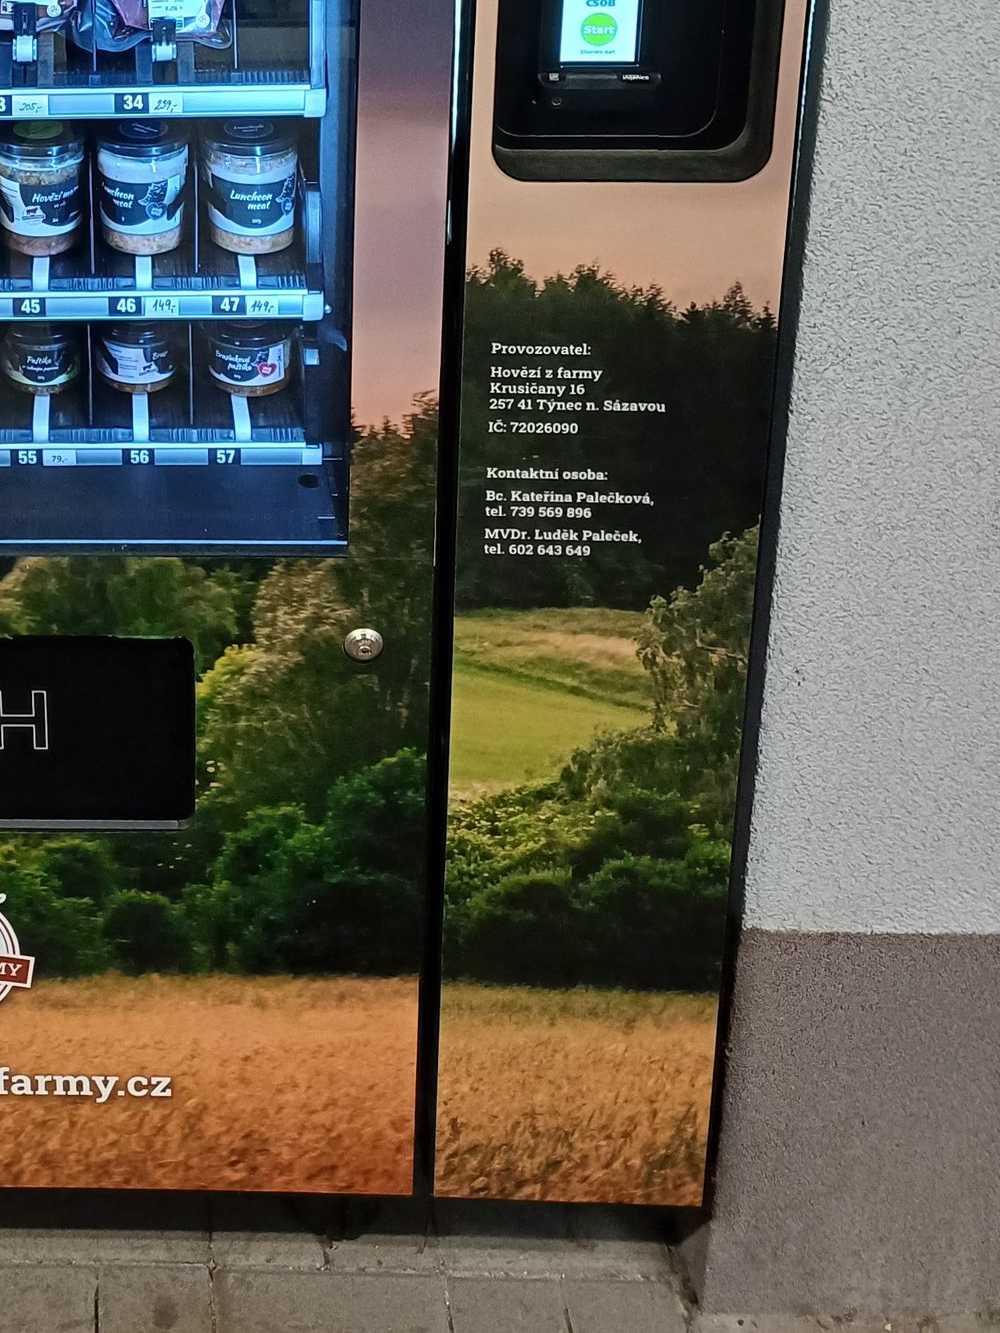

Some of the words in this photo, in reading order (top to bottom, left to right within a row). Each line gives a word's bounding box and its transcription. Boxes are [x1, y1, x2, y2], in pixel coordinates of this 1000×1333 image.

[583, 25, 615, 35] Start
[123, 94, 143, 110] 34
[32, 190, 63, 203] Hovězí
[230, 190, 272, 201] Luncheon
[247, 201, 271, 211] meat
[20, 299, 40, 314] 45
[117, 298, 136, 313] 46
[220, 297, 240, 312] 47
[491, 342, 592, 356] Provozovatel:
[490, 365, 542, 378] Hovězí
[545, 370, 553, 378] z
[557, 367, 603, 381] farmy
[489, 382, 566, 397] Krusičany
[569, 384, 585, 395] 16
[489, 399, 515, 410] 257
[517, 399, 533, 410] 41
[537, 398, 582, 413] Týnec
[585, 402, 600, 411] n.
[603, 399, 667, 413] Sázavou
[488, 419, 507, 433] IČ:
[510, 422, 579, 434] 72026090
[18, 450, 38, 463] 55
[51, 455, 68, 464] 79,-
[130, 450, 149, 464] 56
[216, 450, 235, 464] 57
[486, 467, 559, 480] Kontaktní
[562, 468, 608, 480] osoba:
[485, 490, 507, 502] Bc.
[510, 490, 573, 503] Kateřina
[576, 491, 655, 506] Palečková,
[485, 506, 506, 517] tel.
[510, 506, 535, 517] 739
[538, 507, 563, 517] 569
[566, 507, 592, 518] 896
[484, 528, 531, 540] MVDr.
[534, 528, 579, 541] Luděk
[582, 529, 642, 544] Paleček,
[484, 543, 505, 555] tel.
[508, 544, 533, 555] 602
[537, 544, 562, 556] 643
[565, 545, 591, 556] 649
